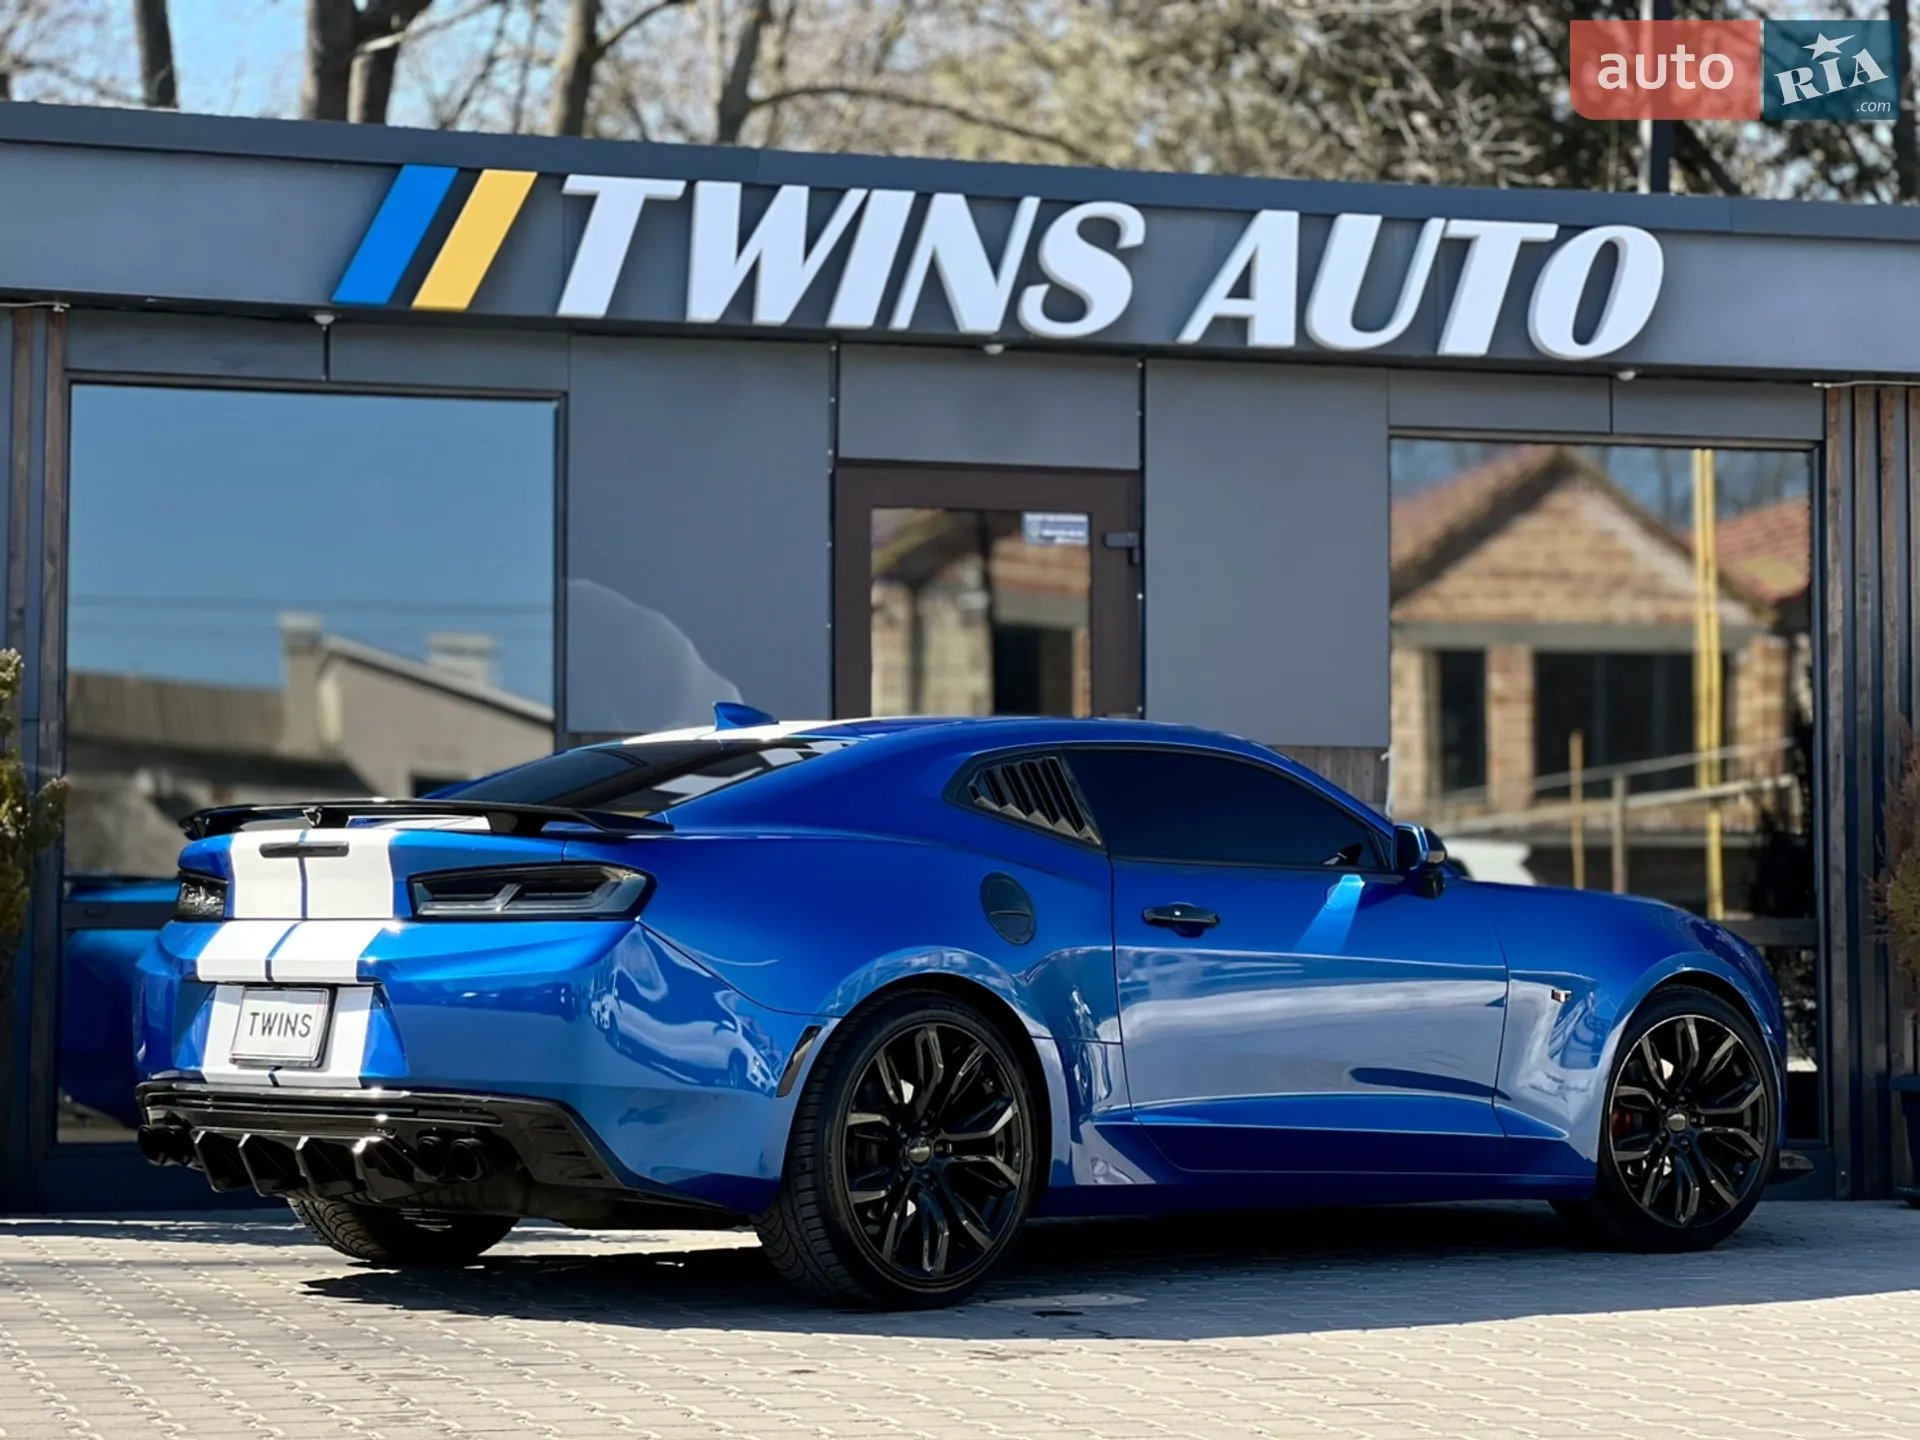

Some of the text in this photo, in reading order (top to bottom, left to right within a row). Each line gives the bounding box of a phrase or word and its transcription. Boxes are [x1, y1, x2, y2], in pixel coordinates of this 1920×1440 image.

[556, 174, 1664, 360] TWINS AUTO
[249, 1011, 312, 1038] TWINS
